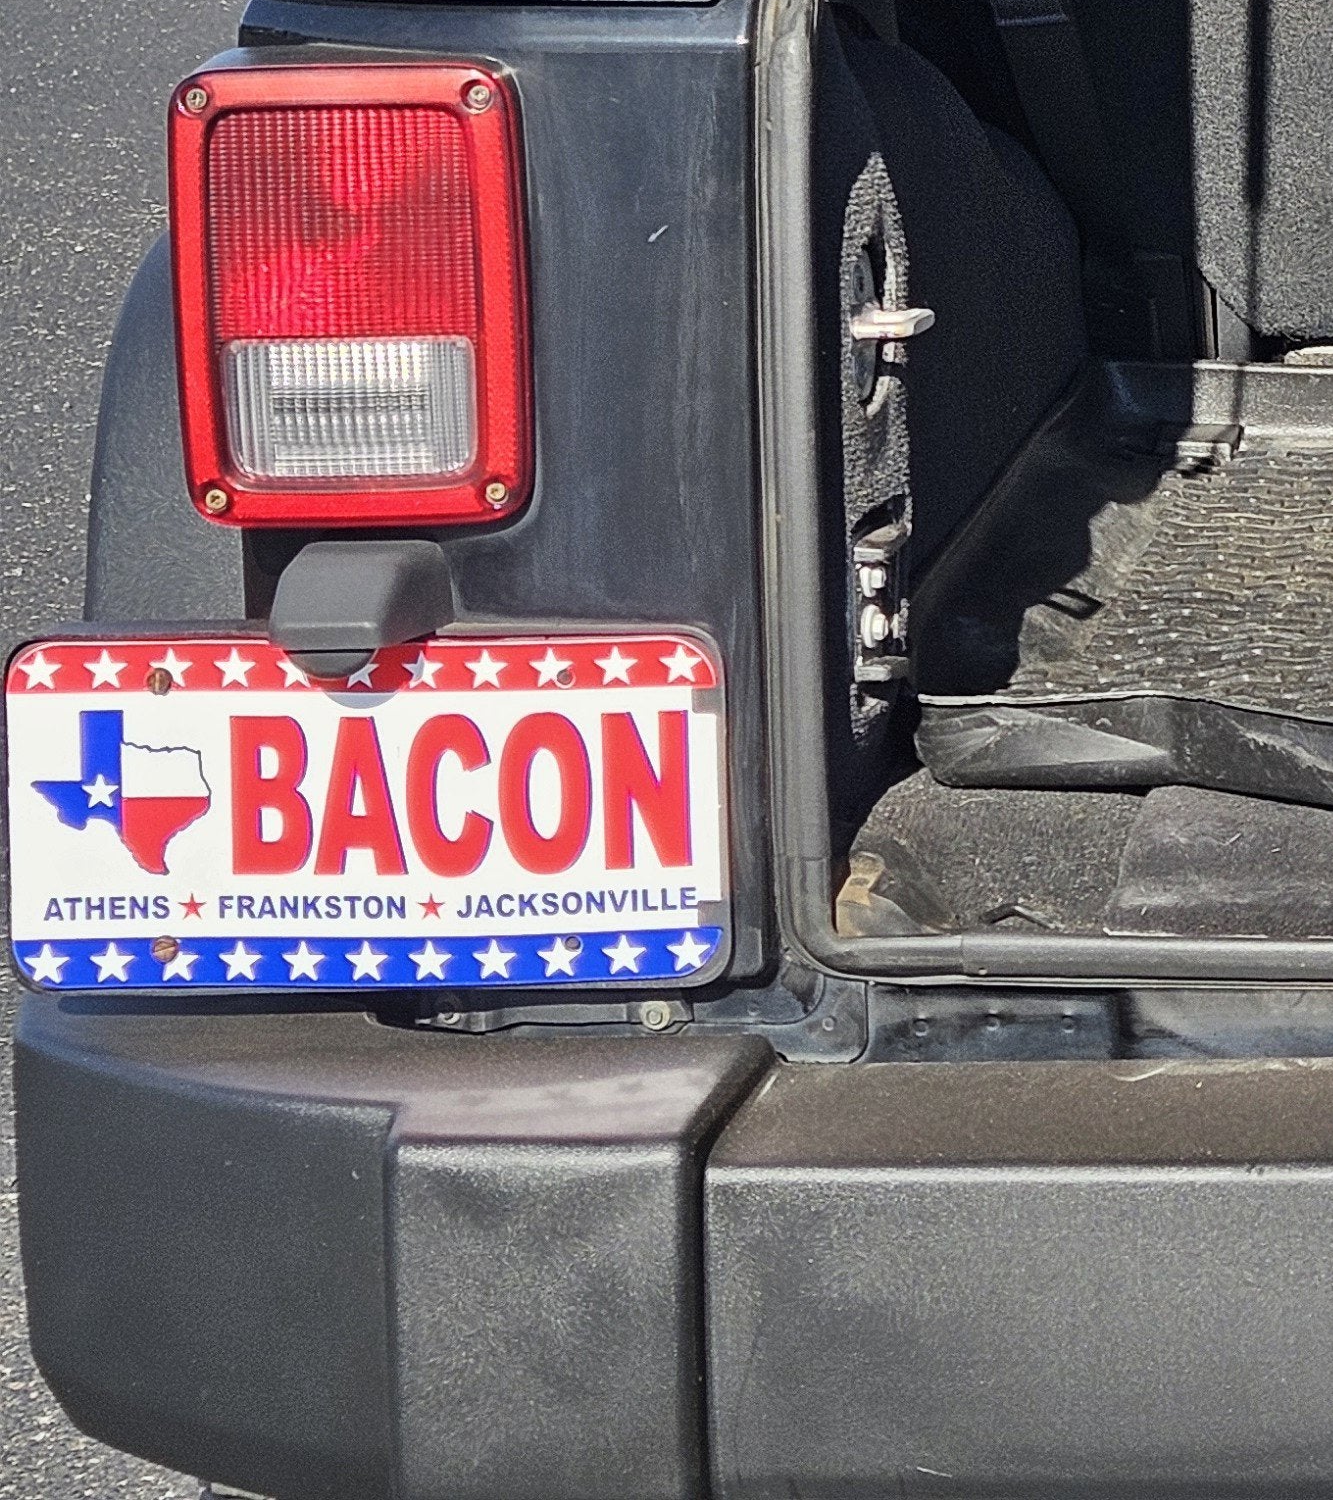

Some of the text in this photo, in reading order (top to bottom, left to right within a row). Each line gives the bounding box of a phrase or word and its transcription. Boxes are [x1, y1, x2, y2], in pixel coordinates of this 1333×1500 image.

[229, 710, 694, 877] BACON
[43, 887, 698, 921] ATHENS FRANKSTON JACKSONVILLE
